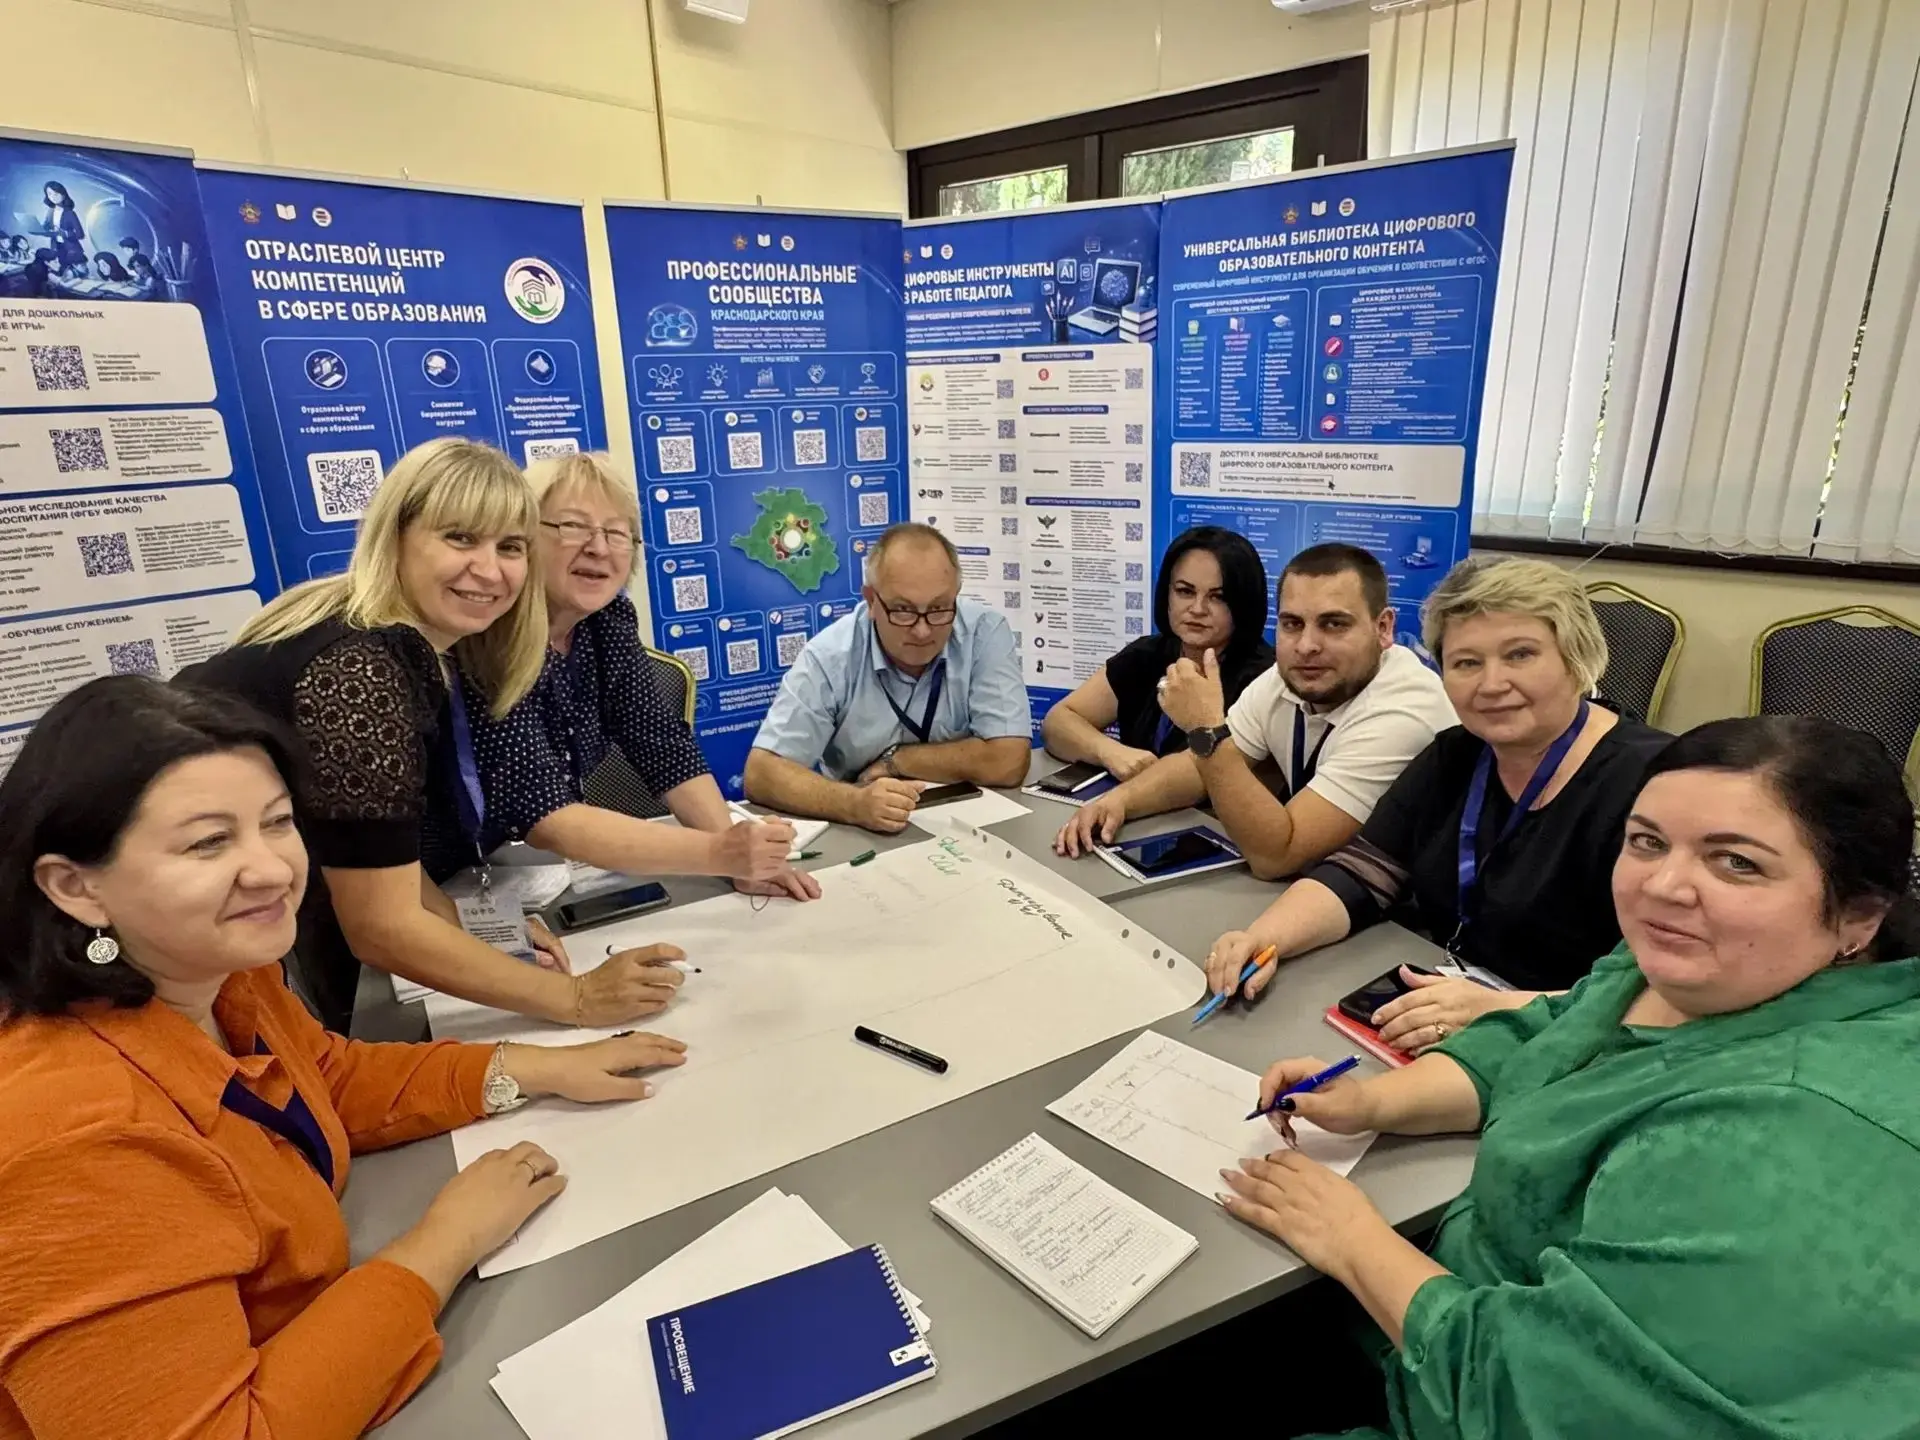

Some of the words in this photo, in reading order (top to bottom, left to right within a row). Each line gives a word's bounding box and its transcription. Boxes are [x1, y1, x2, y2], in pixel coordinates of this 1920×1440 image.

[1184, 235, 1287, 258] УНИВЕРСАЛЬНАЯ
[1290, 226, 1380, 246] БИБЛИОТЕКА
[1384, 211, 1476, 238] ЦИФРОВОГО
[245, 239, 383, 266] ОТРАСЛЕВОЙ
[386, 247, 445, 270] ЦЕНТР
[1219, 246, 1349, 273] ОБРАЗОВАТЕЛЬНОГО
[1353, 238, 1425, 260] КОНТЕНТА
[667, 261, 857, 283] ПРОФЕССИОНАЛЬНЫЕ
[966, 261, 1054, 282] ИНСТРУМЕНТЫ
[1251, 273, 1291, 284] ИНСТРУМЕНТ
[1292, 271, 1307, 281] ДЛЯ
[1308, 265, 1356, 279] ОРГАНИЗАЦИИ
[1357, 263, 1394, 275] ОБУЧЕНИЯ
[251, 270, 406, 297] КОМПЕТЕНЦИЙ
[709, 285, 824, 307] СООБЩЕСТВА
[911, 287, 953, 304] РАБОТЕ
[955, 284, 1013, 302] ПЕДАГОГА
[3, 309, 26, 318] ДЛЯ
[28, 309, 105, 319] ДОШКОЛЬНЫХ
[258, 300, 273, 319] В
[277, 300, 349, 322] СФЕРЕ
[352, 302, 487, 324] ОБРАЗОВАНИЯ
[711, 309, 798, 321] КРАСНОДАРСКОГО
[800, 309, 824, 320] КРАЯ
[301, 404, 344, 414] Отраслевой
[345, 405, 367, 414] центр
[431, 400, 464, 408] Снижение
[306, 425, 328, 435] сфере
[329, 424, 375, 433] образования
[312, 415, 360, 424] компетенций
[435, 419, 465, 428] нагрузки
[1219, 450, 1249, 458] ДОСТУП
[1257, 450, 1323, 460] УНИВЕРСАЛЬНОЙ
[1324, 452, 1379, 460] БИБЛИОТЕКЕ
[1219, 461, 1264, 469] ЦИФРОВОГО
[1266, 462, 1348, 471] ОБРАЗОВАТЕЛЬНОГО
[1350, 463, 1394, 472] КОНТЕНТА
[29, 499, 113, 512] ИССЛЕДОВАНИЕ
[116, 494, 168, 505] КАЧЕСТВА
[70, 509, 101, 519] (ФГБУ
[103, 505, 143, 515] ФИОКО)
[2, 624, 64, 639] «ОБУЧЕНИЕ
[65, 614, 134, 630] СЛУЖЕНИЕМ»
[669, 1316, 696, 1395] ПРОСВЕЩЕНИЕ
